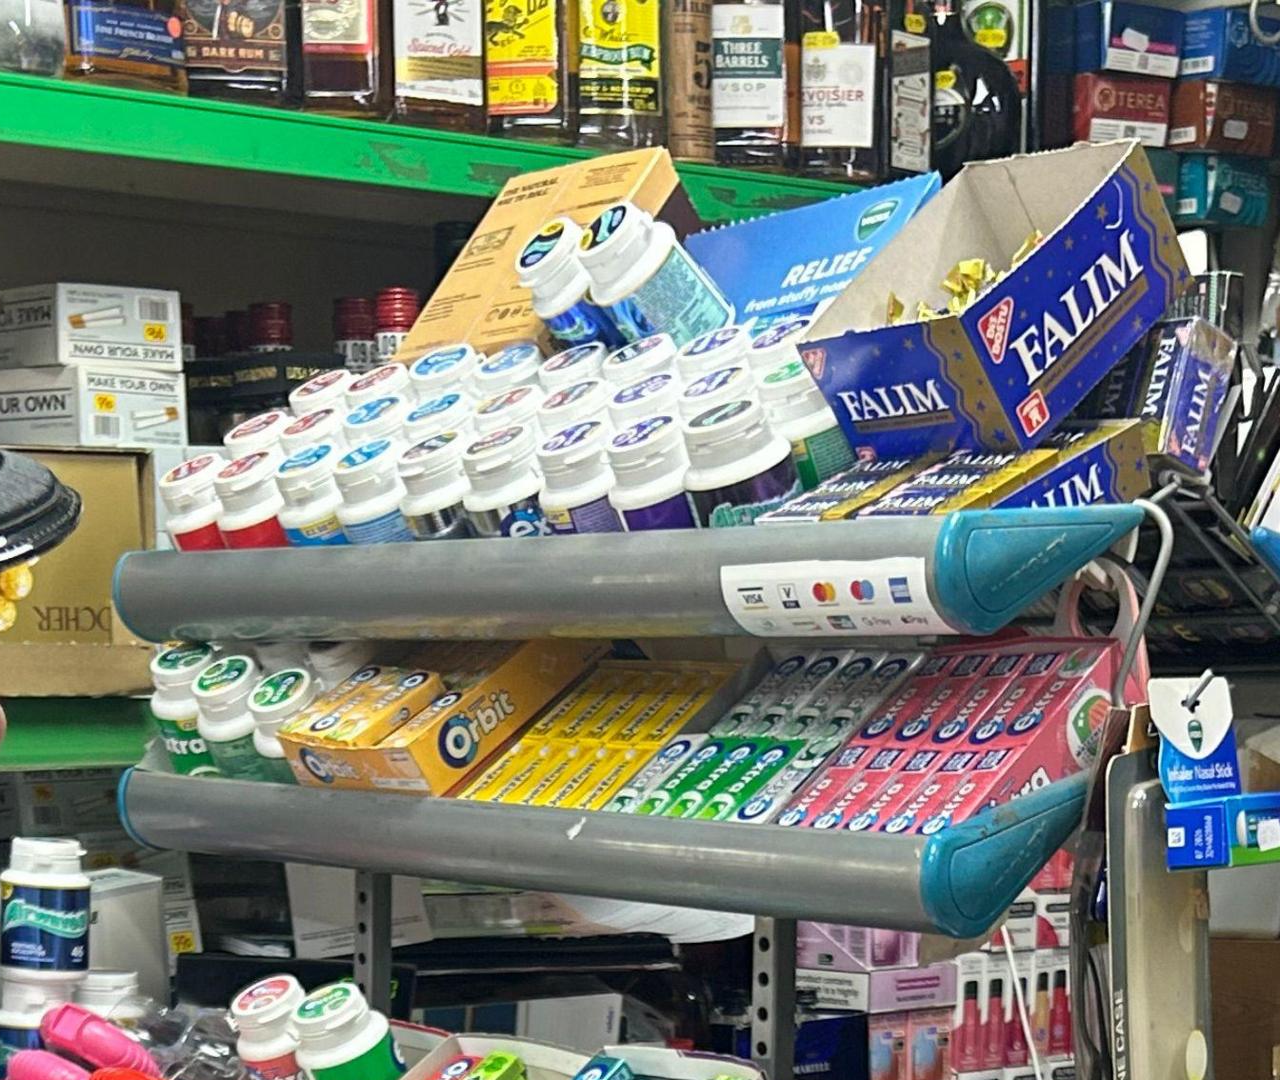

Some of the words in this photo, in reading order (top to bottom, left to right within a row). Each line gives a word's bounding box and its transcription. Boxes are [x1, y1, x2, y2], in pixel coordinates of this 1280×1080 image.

[202, 47, 231, 59] DARK
[234, 47, 265, 59] RUM
[715, 55, 769, 70] BARRELS
[722, 41, 763, 56] THREE
[718, 81, 767, 93] VSOP
[1118, 92, 1165, 110] TEREA
[808, 114, 825, 127] VS
[781, 247, 873, 289] RELIEF
[1008, 229, 1147, 386] FALIM
[86, 375, 117, 389] MAKE
[118, 377, 148, 391] YOUR
[150, 379, 175, 393] OWN
[1142, 336, 1177, 416] FALIM
[19, 394, 66, 412] OWN
[837, 379, 949, 421] FALIM
[1181, 372, 1212, 455] FALIM
[38, 605, 111, 631] OCHER
[742, 593, 763, 604] VISA
[940, 688, 987, 740] extra
[976, 688, 1025, 740] extra
[1014, 681, 1064, 732] extra
[437, 689, 515, 769] Orbit
[1194, 764, 1215, 780] Nasal
[1215, 763, 1233, 779] Stick
[778, 778, 830, 827] extra
[813, 781, 867, 829] extra
[848, 782, 904, 832] extra
[884, 783, 942, 833] extra
[921, 782, 975, 835] extra
[71, 946, 84, 958] 46
